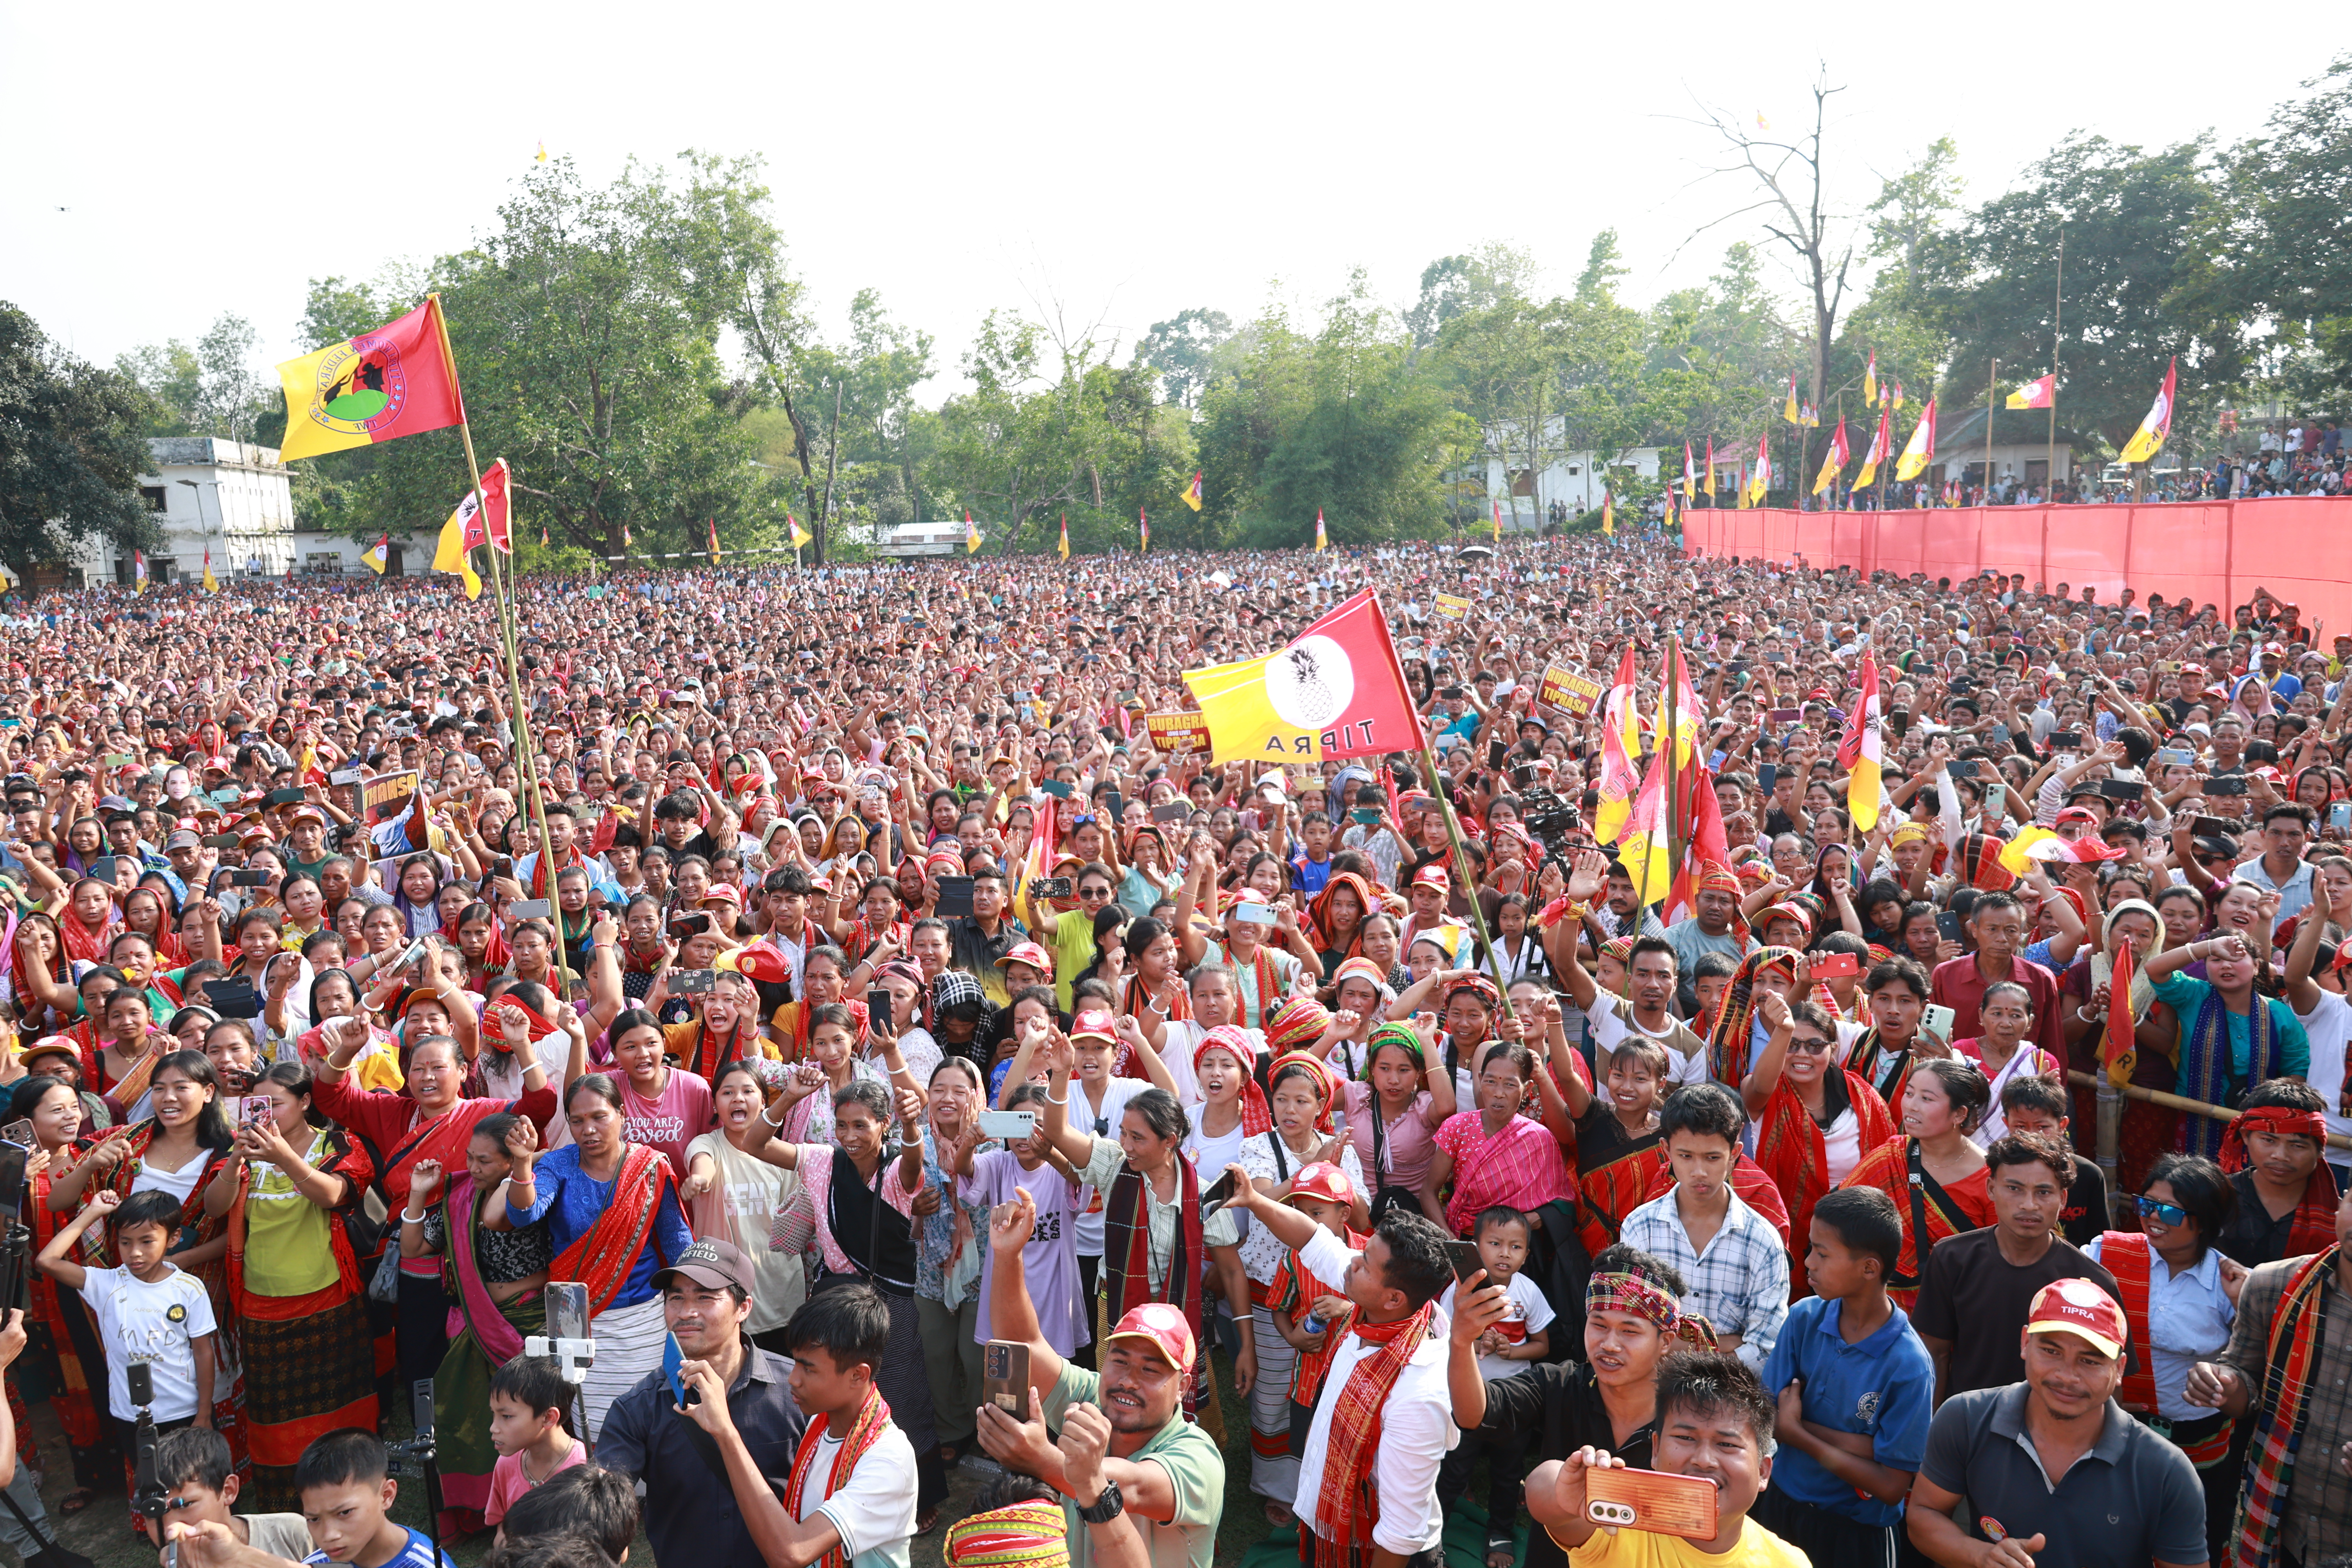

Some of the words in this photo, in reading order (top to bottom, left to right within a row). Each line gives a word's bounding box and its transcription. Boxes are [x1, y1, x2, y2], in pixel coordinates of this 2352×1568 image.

[1436, 595, 1468, 608] BUBAGRA
[1435, 604, 1463, 618] TIPRASA
[1545, 668, 1599, 700] BUBAGRA
[1543, 686, 1588, 715] TIPRASA
[1568, 690, 1579, 698] LIVE!
[1148, 715, 1207, 731] BUBAGRA
[364, 773, 416, 809] THANSA
[630, 1116, 650, 1127] YOU
[653, 1116, 674, 1127] ARE
[723, 1181, 764, 1216] GEN
[2061, 1306, 2095, 1321] TIPRA
[1136, 1323, 1161, 1339] TIPRA
